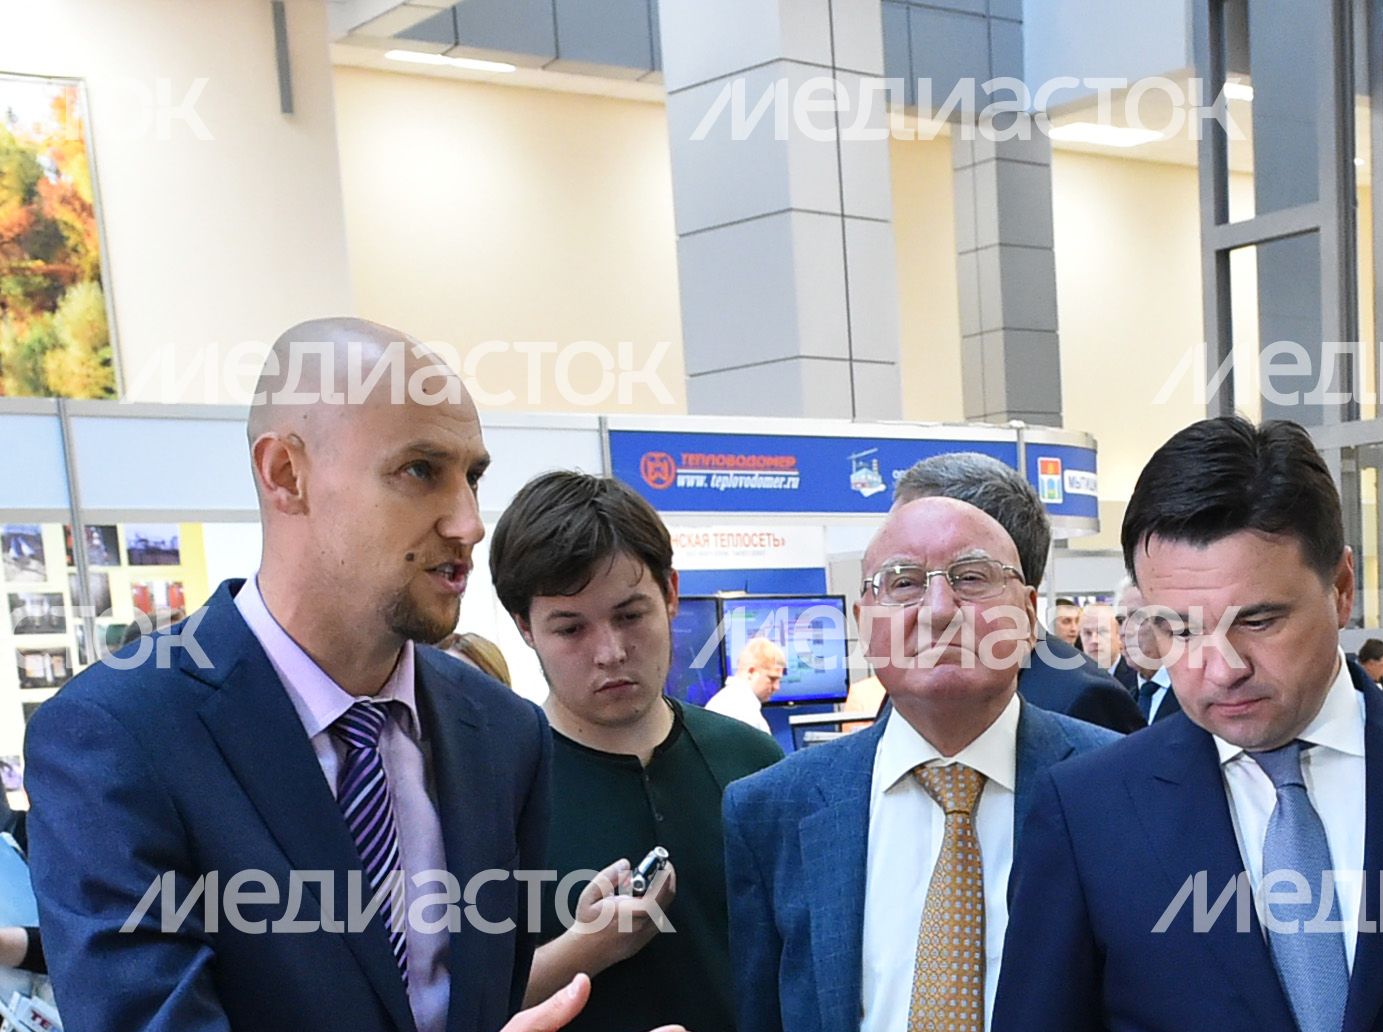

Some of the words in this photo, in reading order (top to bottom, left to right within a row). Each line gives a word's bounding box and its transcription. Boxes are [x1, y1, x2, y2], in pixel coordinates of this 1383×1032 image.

[680, 453, 797, 470] ТЕПЛОВОДОМЕР
[710, 472, 800, 491] teplovodomer.ru
[713, 532, 786, 548] ТЕПЛОСЕТЬ»
